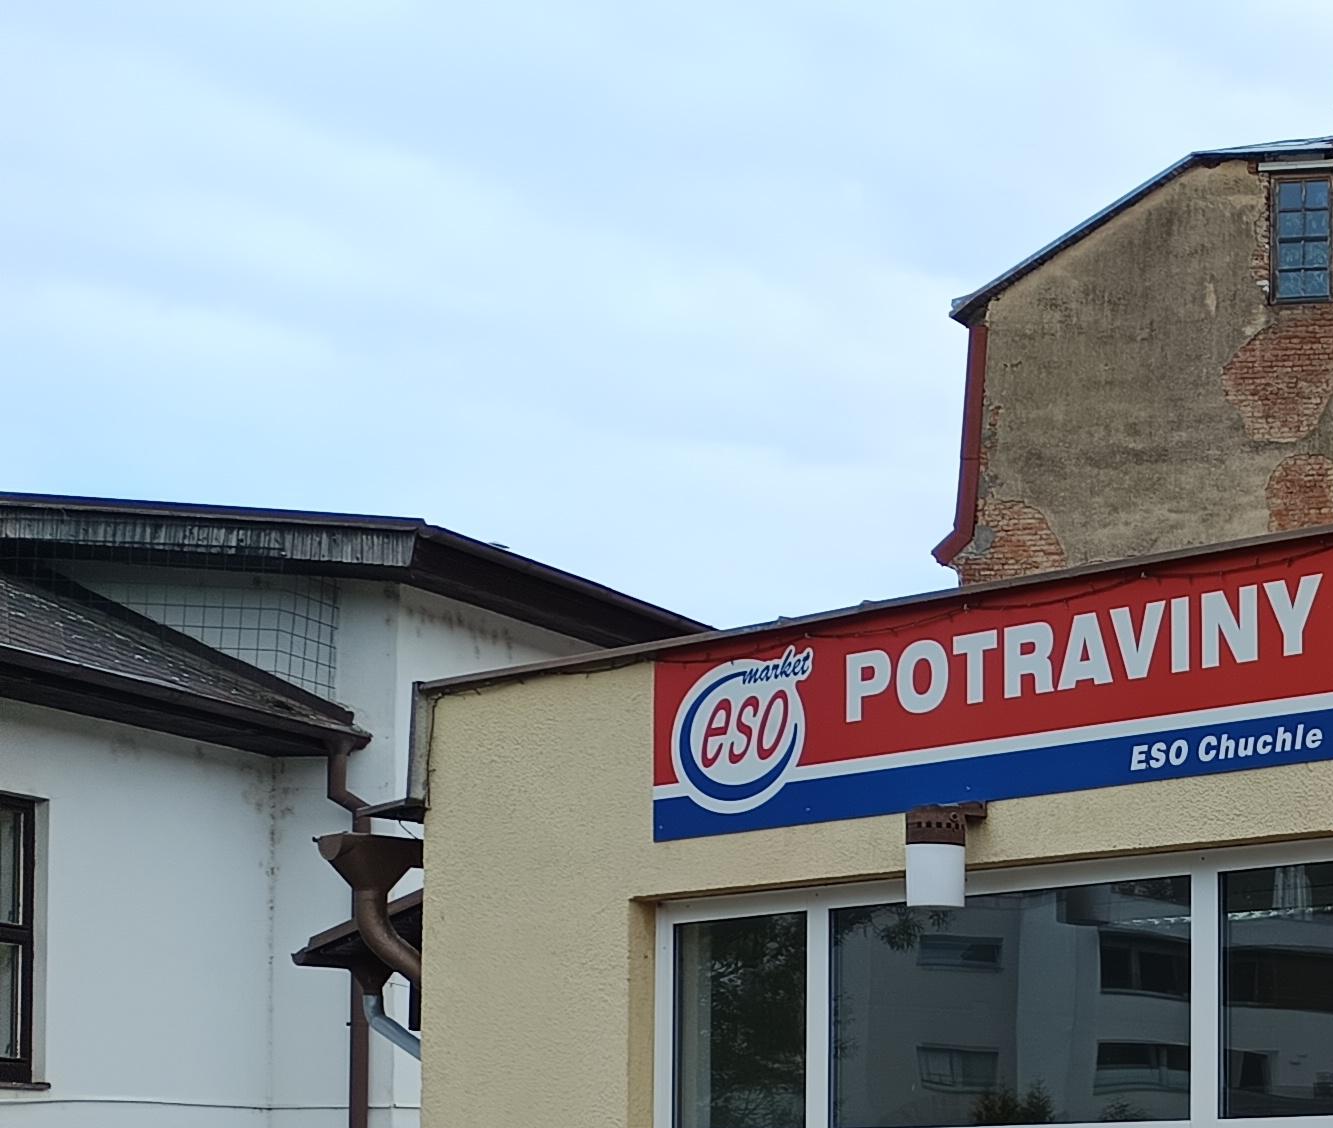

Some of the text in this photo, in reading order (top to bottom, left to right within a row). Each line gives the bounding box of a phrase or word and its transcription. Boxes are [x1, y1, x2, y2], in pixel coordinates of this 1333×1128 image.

[742, 649, 810, 685] market
[845, 573, 1323, 722] POTRAVINY
[701, 689, 789, 768] eso
[1130, 724, 1323, 771] ESO Chuchle
